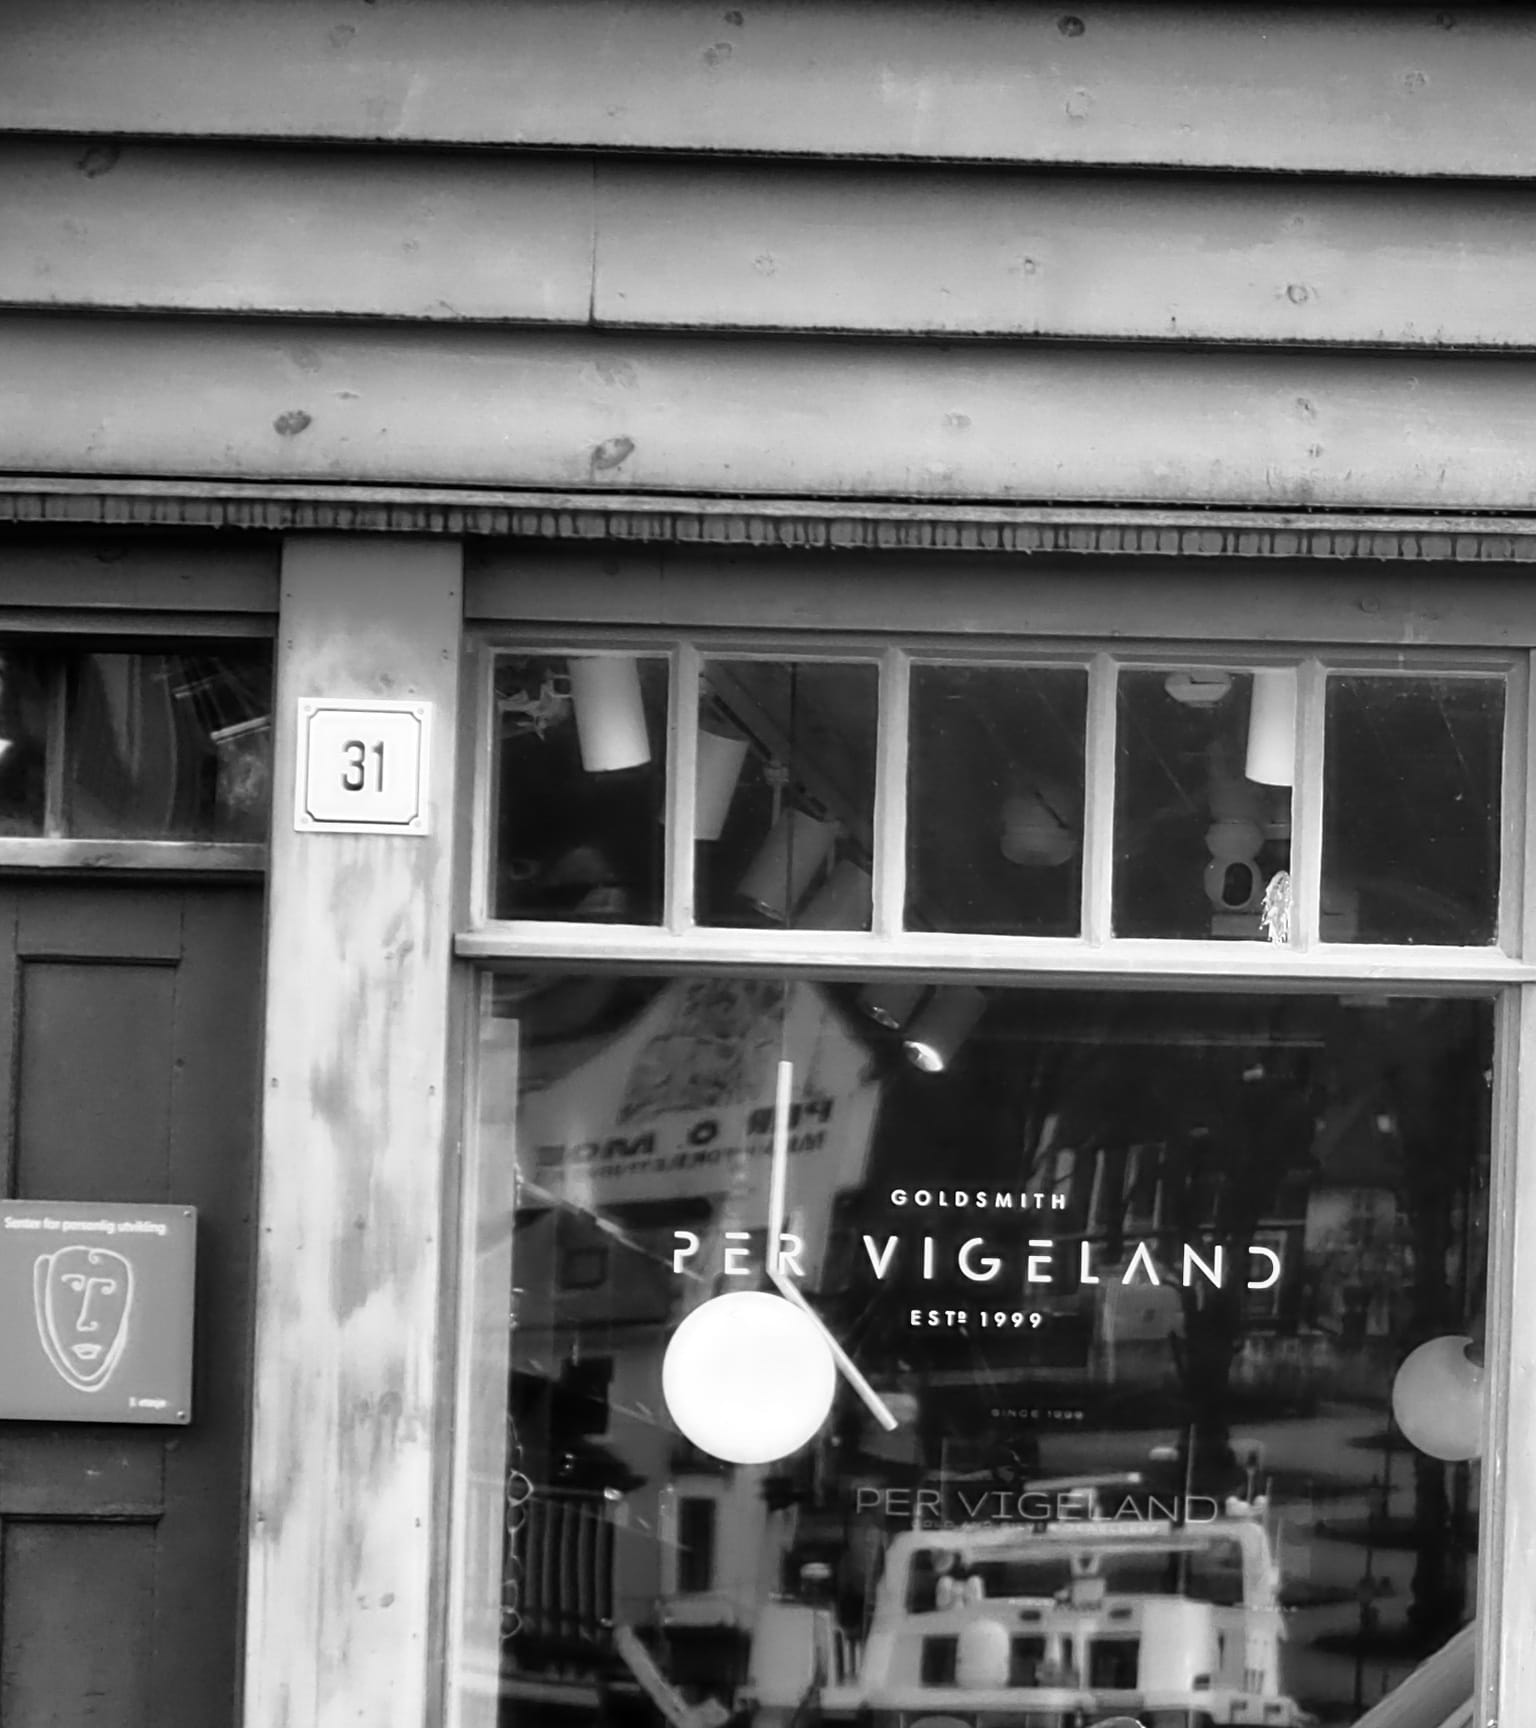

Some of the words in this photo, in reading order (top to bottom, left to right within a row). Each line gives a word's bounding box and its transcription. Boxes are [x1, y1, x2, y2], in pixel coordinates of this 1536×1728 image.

[342, 739, 385, 793] 31
[890, 1188, 1067, 1211] GOLDSMITH
[672, 1231, 805, 1276] PER
[863, 1235, 1283, 1290] VIGELAND
[980, 1311, 1043, 1329] 1999
[991, 1409, 1040, 1419] SINCE
[855, 1487, 941, 1517] PER
[957, 1490, 1219, 1524] VIGELAND
